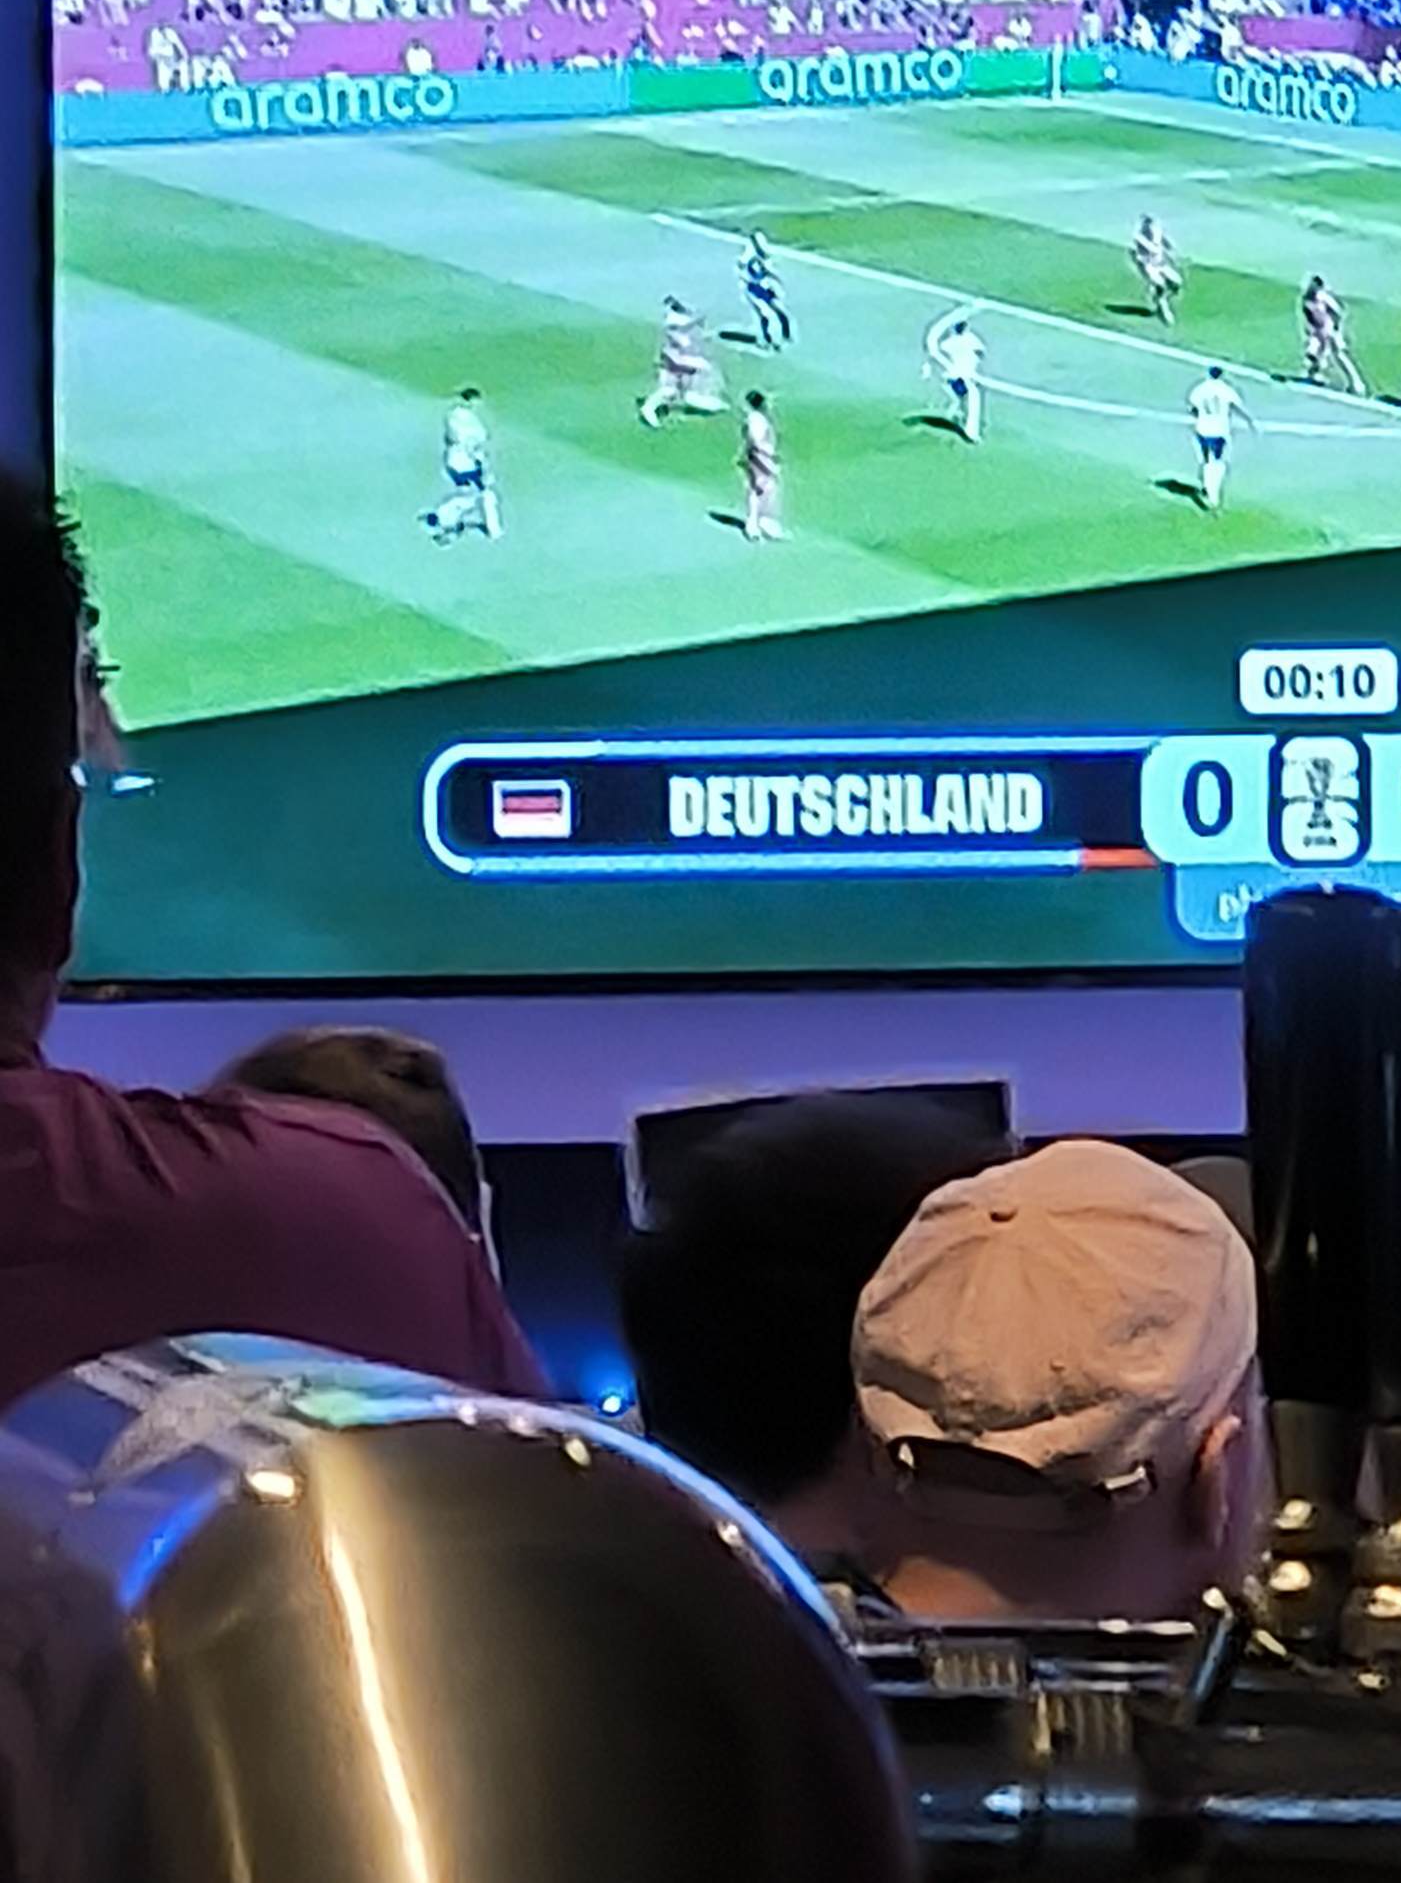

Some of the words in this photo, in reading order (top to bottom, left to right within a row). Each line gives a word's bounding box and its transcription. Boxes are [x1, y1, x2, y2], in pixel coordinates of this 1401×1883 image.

[211, 73, 454, 129] aramco
[758, 50, 963, 103] aramco
[1216, 66, 1356, 124] aramco
[1263, 663, 1376, 700] 00:10
[668, 773, 1044, 838] DEUTSCHLAND
[1182, 759, 1234, 837] 0
